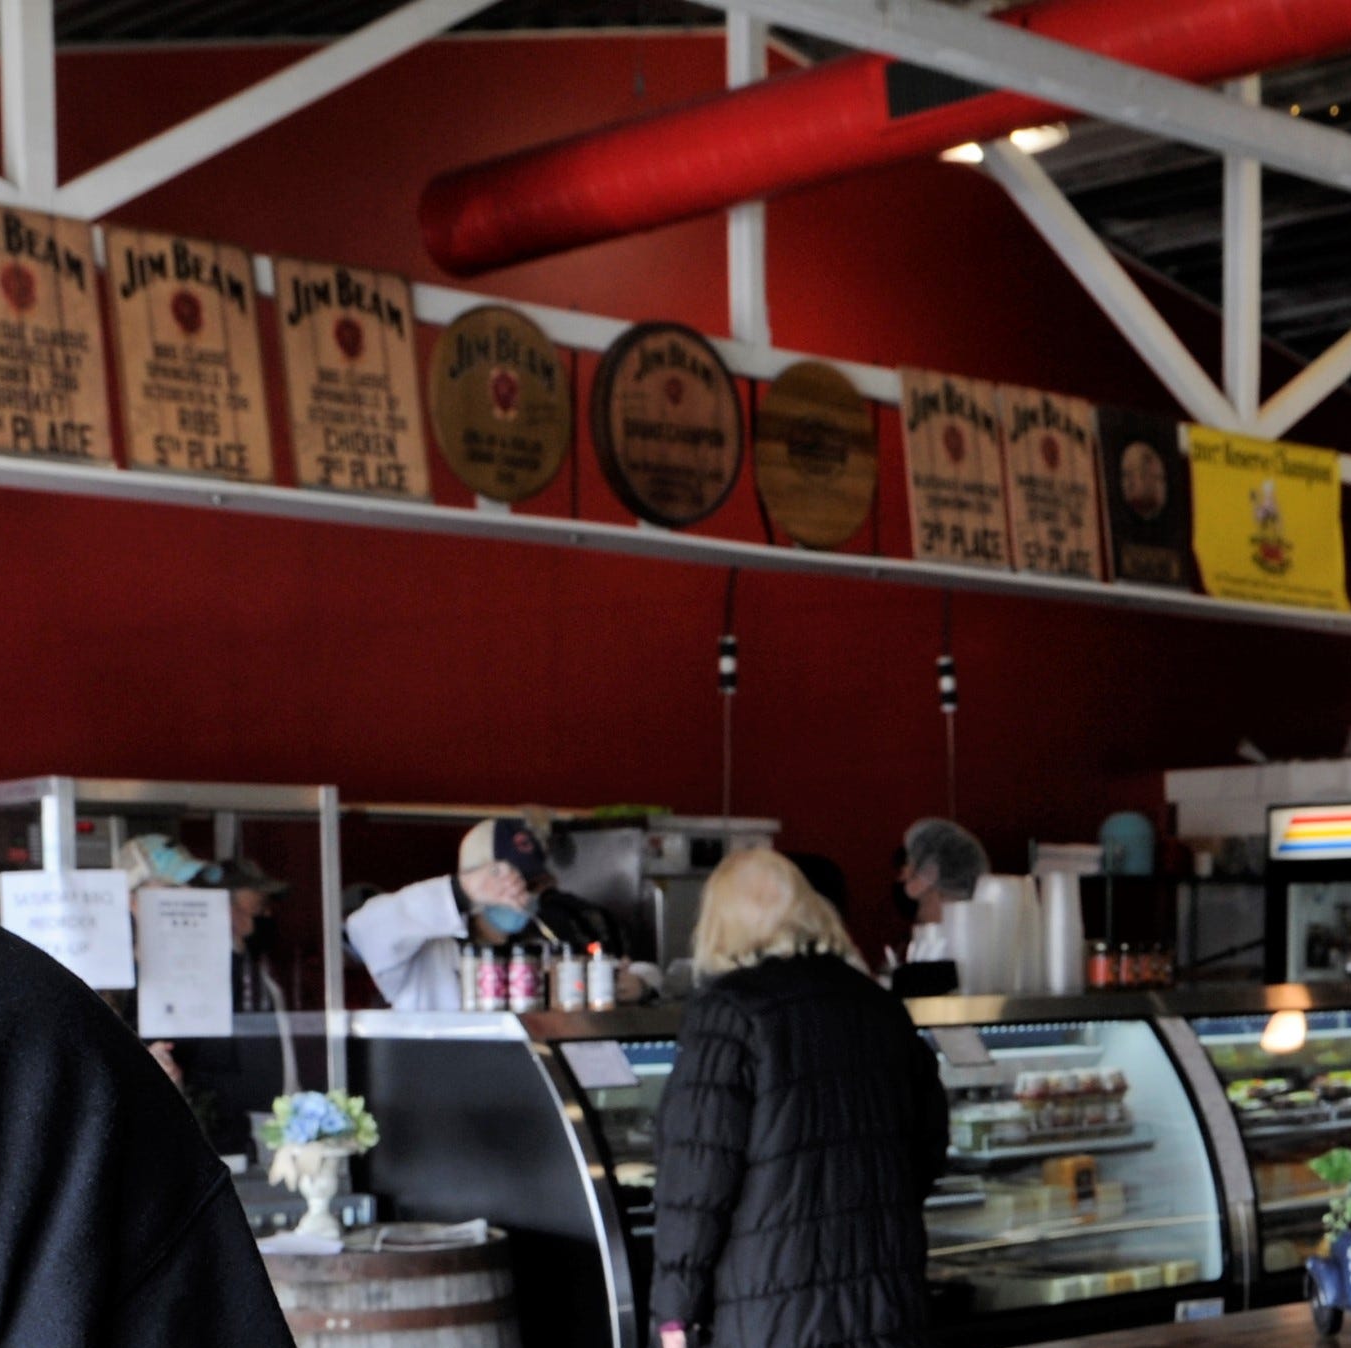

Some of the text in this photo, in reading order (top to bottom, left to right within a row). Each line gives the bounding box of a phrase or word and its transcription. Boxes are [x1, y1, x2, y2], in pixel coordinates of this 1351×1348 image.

[3, 211, 85, 292] BEAM
[121, 238, 245, 315] JIM BEAM
[287, 267, 404, 341] JIM BEAM
[449, 326, 556, 393] JIM BEAM
[11, 414, 93, 456] PLACE
[187, 438, 249, 475] PLACE
[350, 459, 408, 494] PLACE
[950, 524, 1003, 561] PLACE
